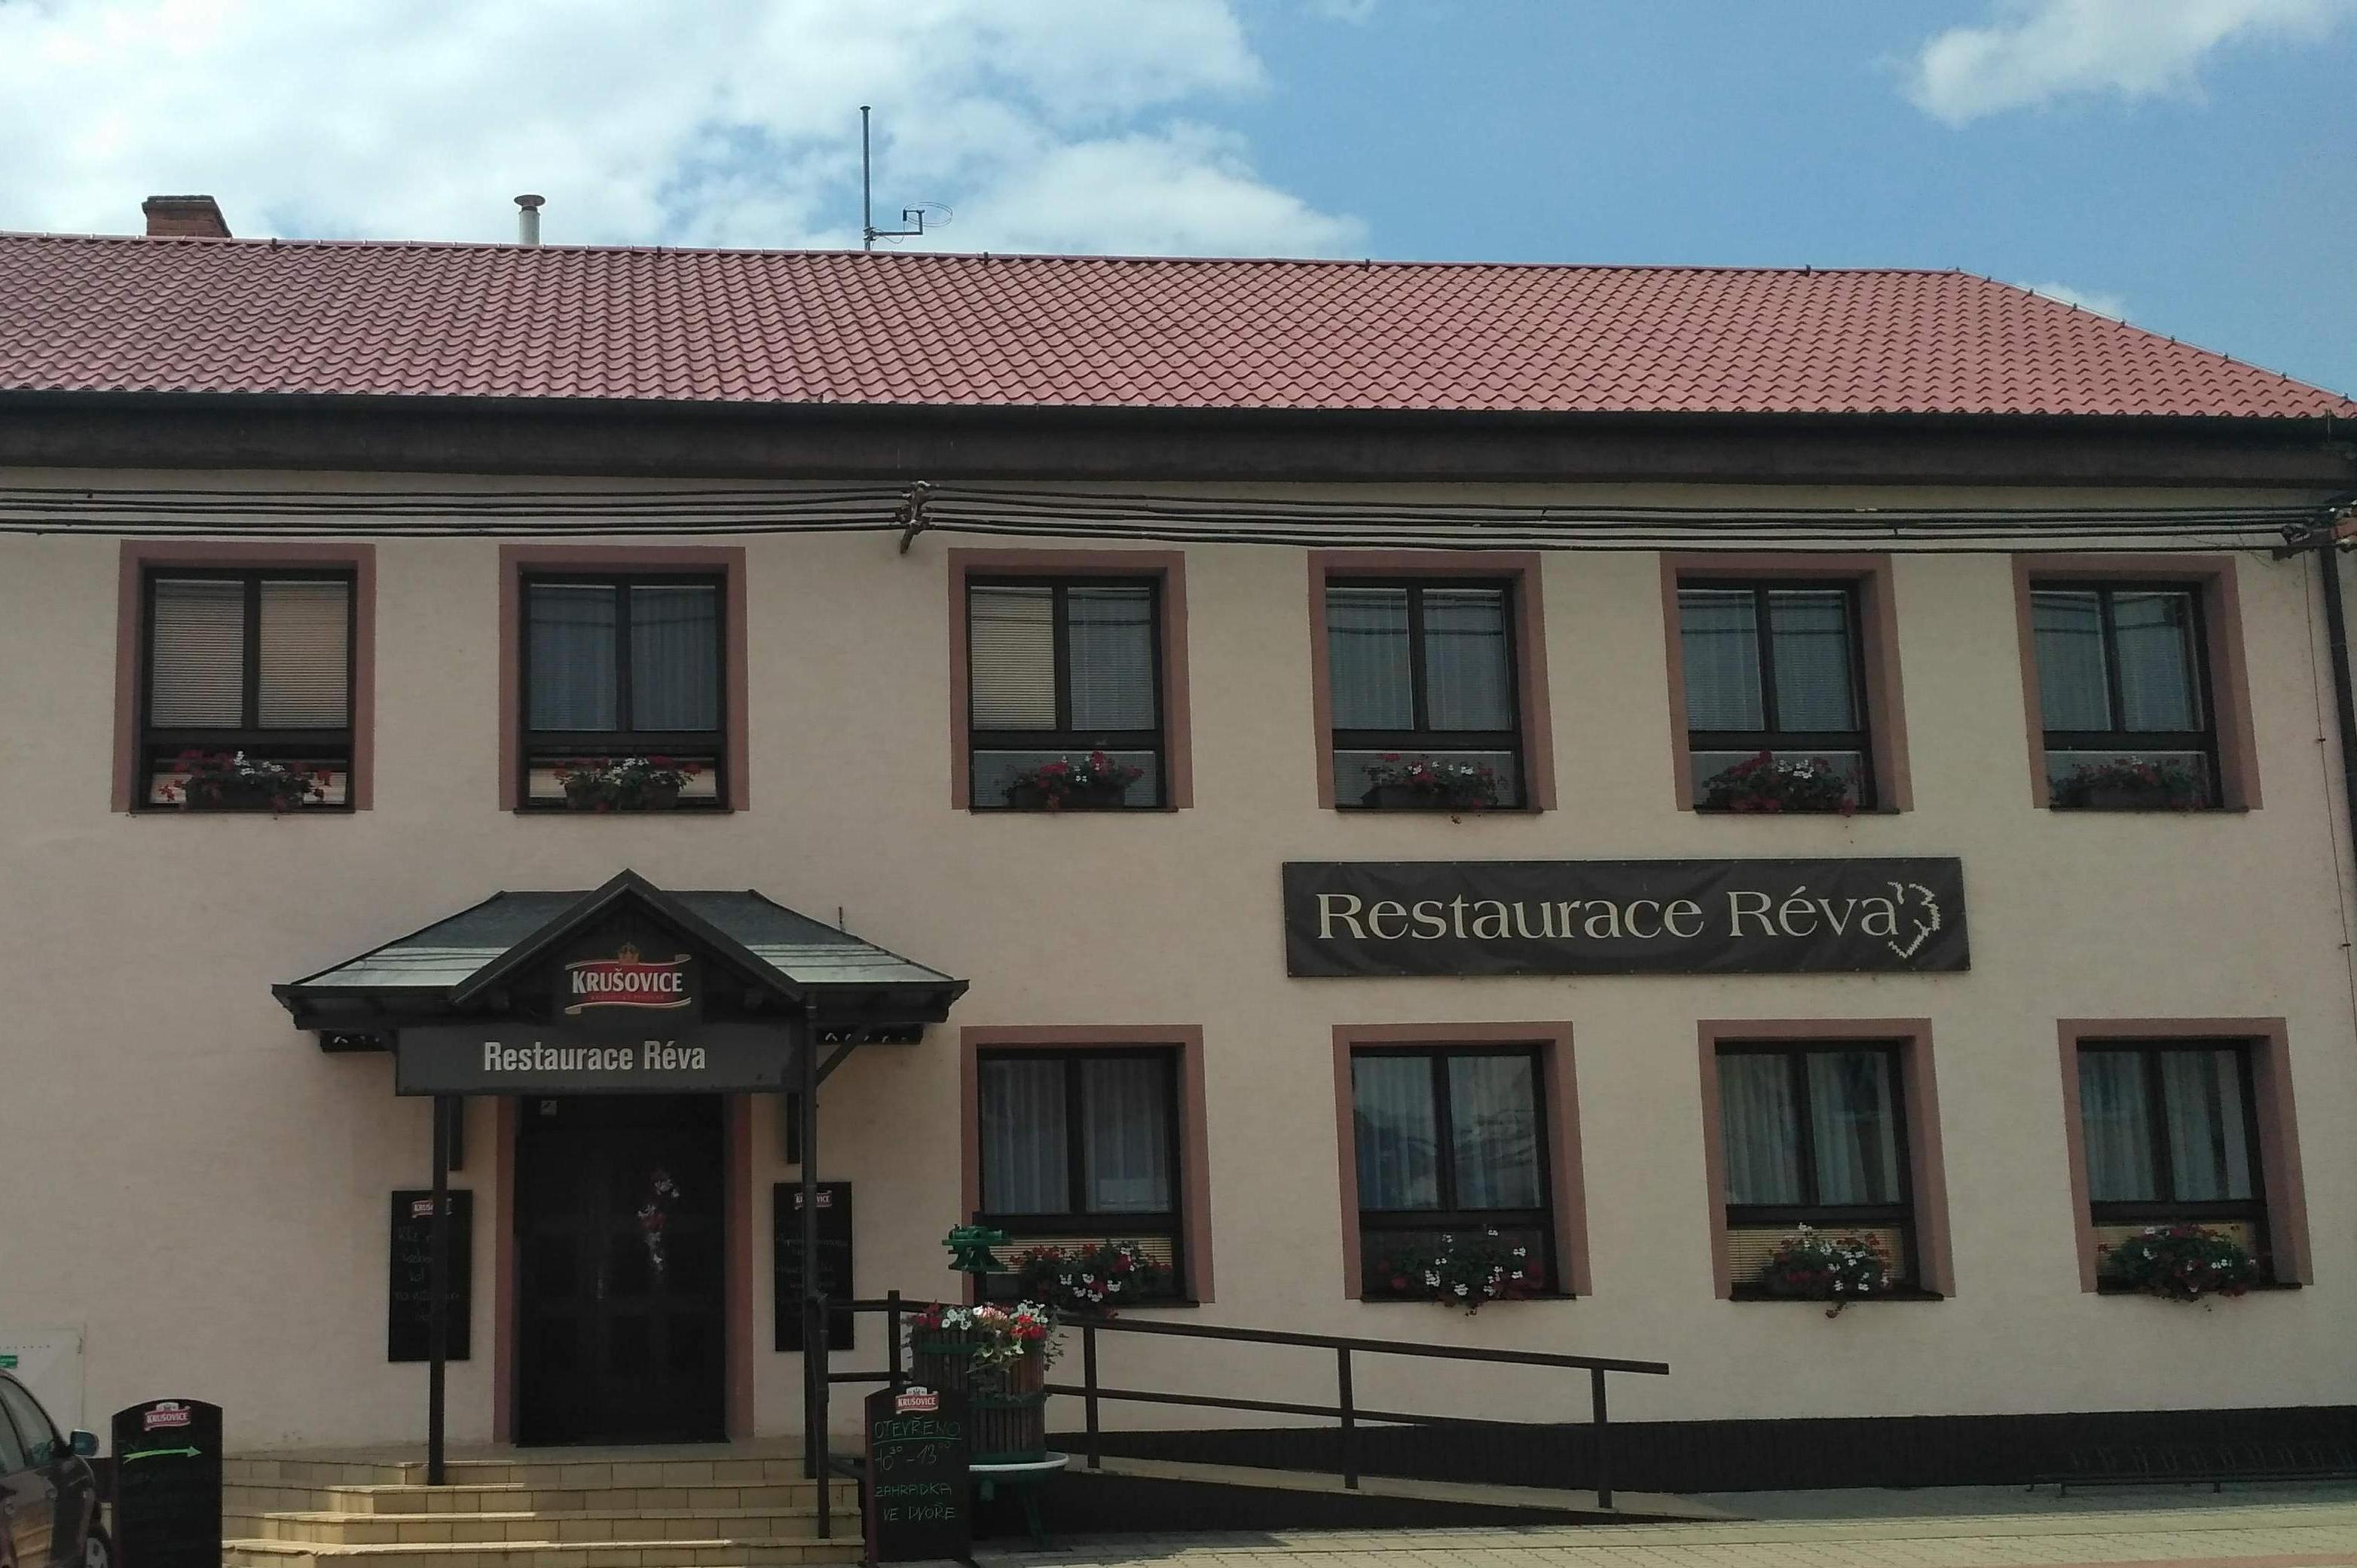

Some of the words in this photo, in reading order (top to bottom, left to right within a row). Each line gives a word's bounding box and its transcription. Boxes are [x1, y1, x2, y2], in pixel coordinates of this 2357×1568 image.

[1315, 892, 1704, 940] Restaurace
[1727, 885, 1899, 938] Réva
[572, 967, 683, 994] KRUŠOVICE
[484, 1041, 633, 1071] Restaurace
[644, 1040, 706, 1071] Réva
[883, 1506, 899, 1521] VE
